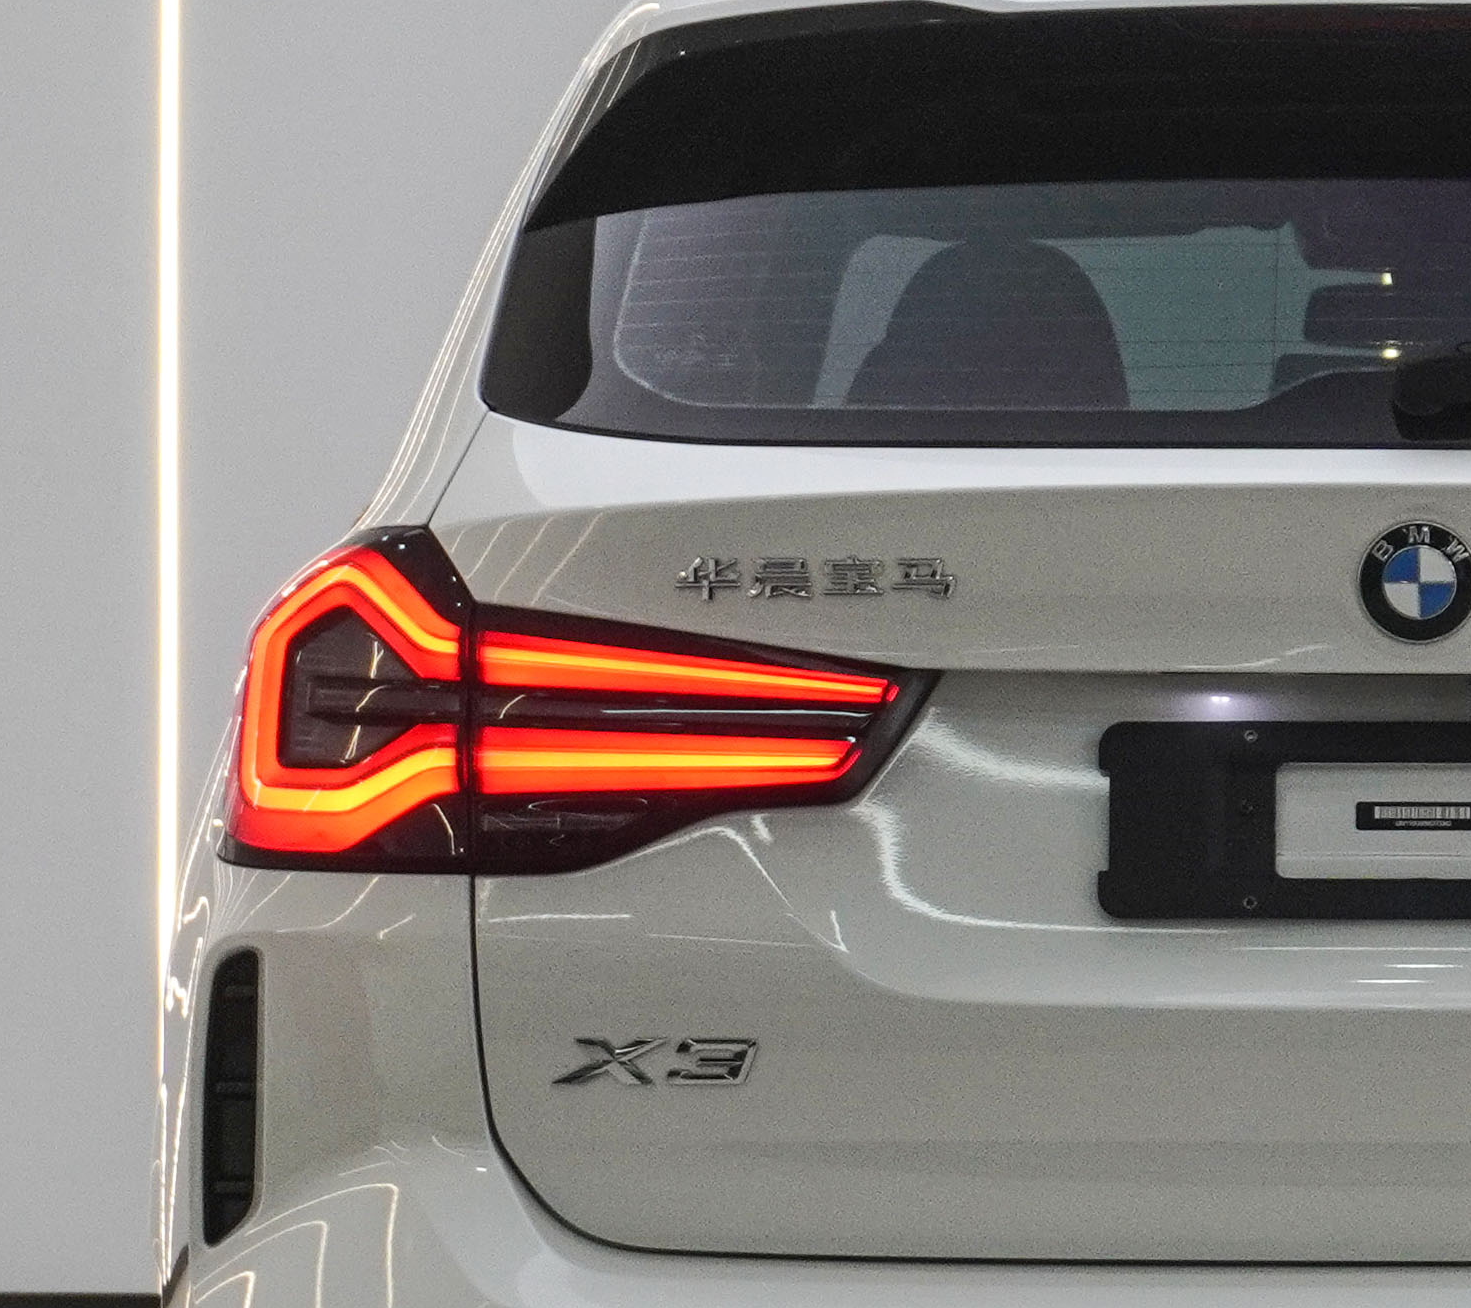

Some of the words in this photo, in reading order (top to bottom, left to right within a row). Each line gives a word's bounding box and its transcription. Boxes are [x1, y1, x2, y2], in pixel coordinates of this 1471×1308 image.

[1372, 525, 1470, 563] BMW
[674, 555, 956, 601] 华晨宝马
[551, 1037, 759, 1086] X3
